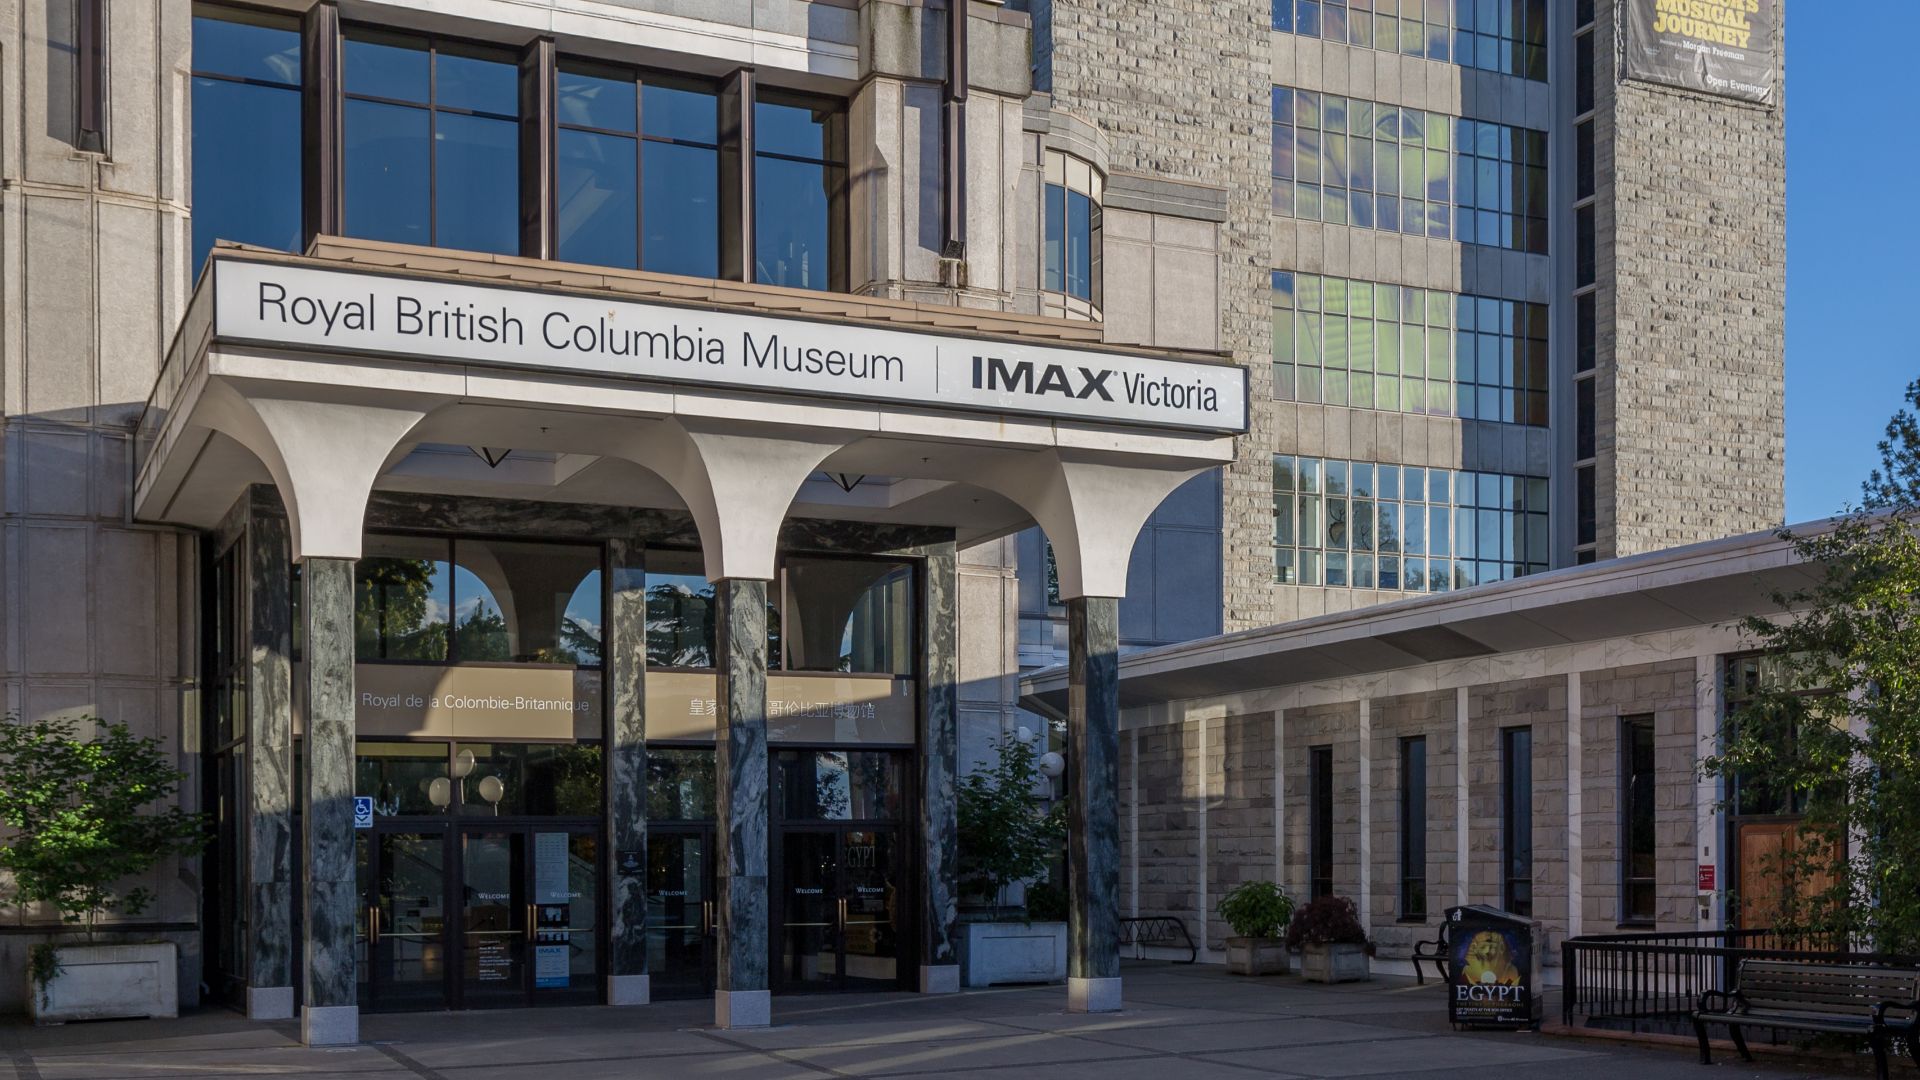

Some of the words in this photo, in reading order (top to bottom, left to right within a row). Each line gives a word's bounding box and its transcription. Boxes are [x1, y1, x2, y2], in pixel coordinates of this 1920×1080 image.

[1656, 0, 1750, 30] MUSICAL
[1653, 11, 1750, 48] JOURNEY
[1682, 40, 1711, 55] Morgan
[1712, 46, 1745, 61] Freeman
[1706, 74, 1728, 88] Open
[1730, 80, 1768, 96] Evenings
[259, 281, 375, 337] Royal
[396, 295, 523, 346] British
[542, 311, 725, 365] Columbia
[743, 331, 904, 382] Museum
[972, 355, 1115, 403] IMAX
[1122, 371, 1219, 412] Victoria
[362, 693, 400, 709] Royal
[406, 694, 423, 708] de
[428, 695, 439, 708] la
[444, 695, 590, 713] Colombie-Britannique
[478, 892, 510, 900] WELCOME
[658, 889, 689, 897] WELCOME
[795, 887, 823, 895] WELCOME
[1456, 985, 1525, 1002] EGYPT
